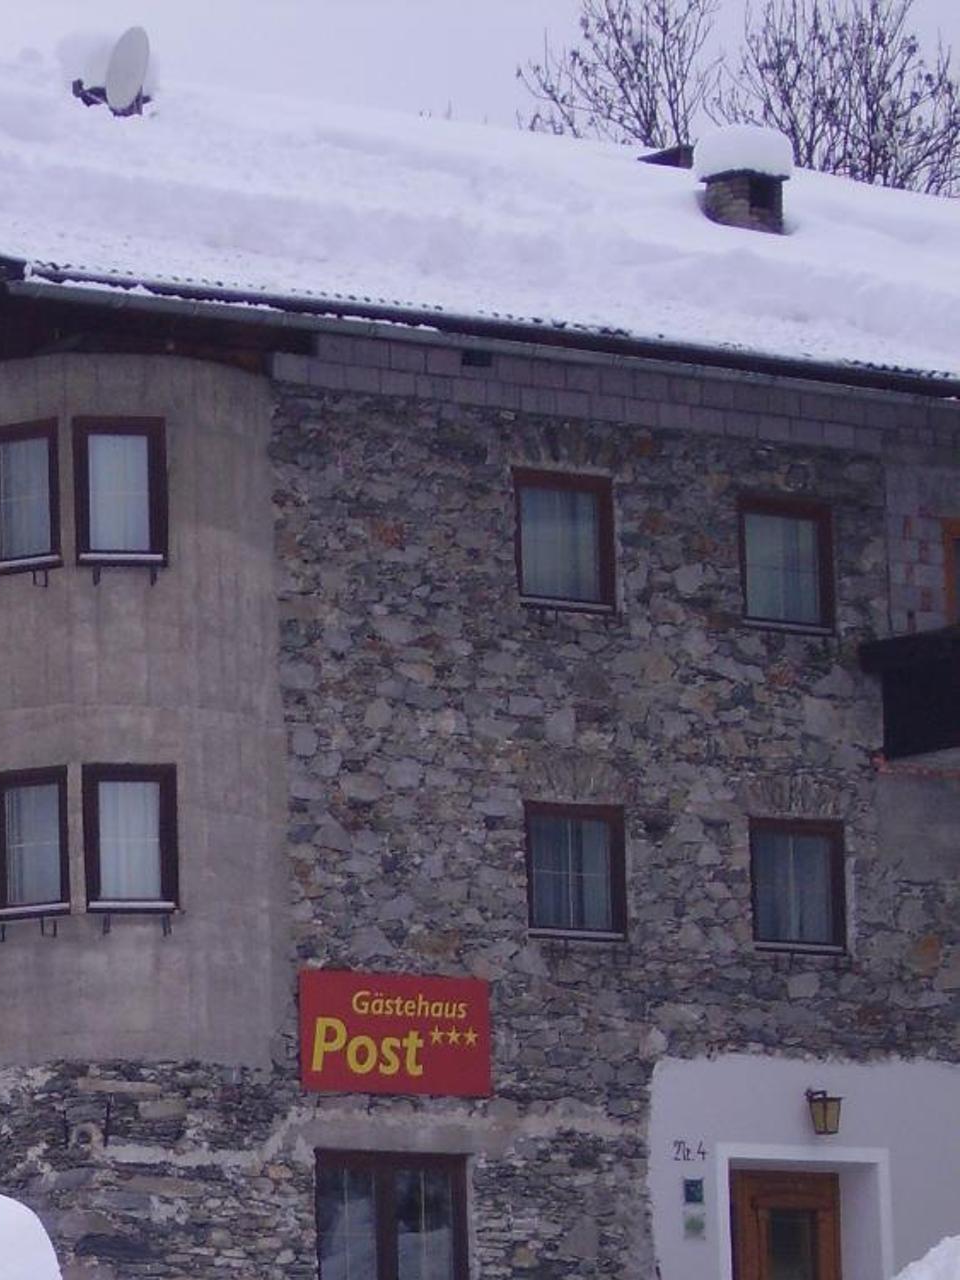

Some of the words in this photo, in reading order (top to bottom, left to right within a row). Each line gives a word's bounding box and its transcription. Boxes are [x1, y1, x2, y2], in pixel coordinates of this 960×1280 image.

[352, 991, 468, 1019] Gästehaus
[312, 1017, 424, 1076] Post
[697, 1139, 707, 1161] 4
